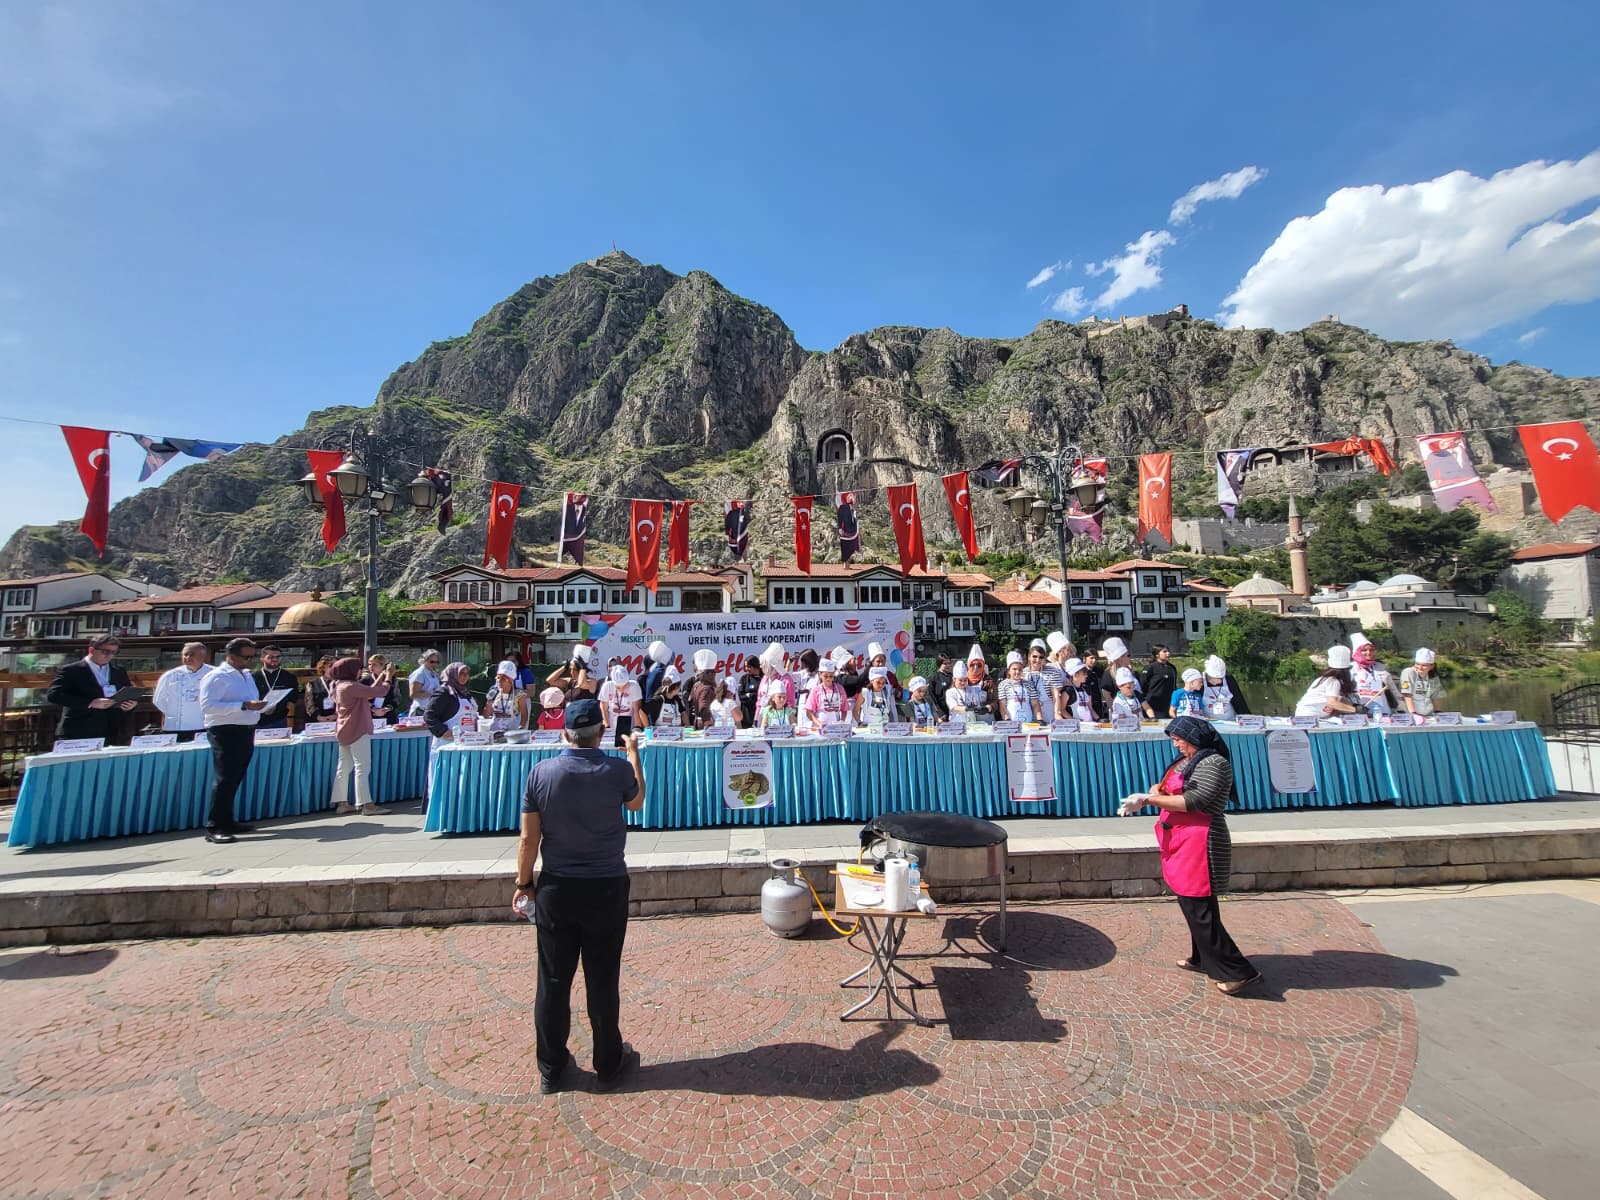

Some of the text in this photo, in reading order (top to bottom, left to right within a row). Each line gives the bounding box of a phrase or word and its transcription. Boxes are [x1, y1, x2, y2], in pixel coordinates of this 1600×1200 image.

[669, 618, 833, 631] AMASYA MİSKET ELLER KADIN GİRİŞİMİ
[620, 634, 645, 643] MİSKET
[688, 633, 815, 646] ÜRETİM İŞLETME KOOPERATİFİ
